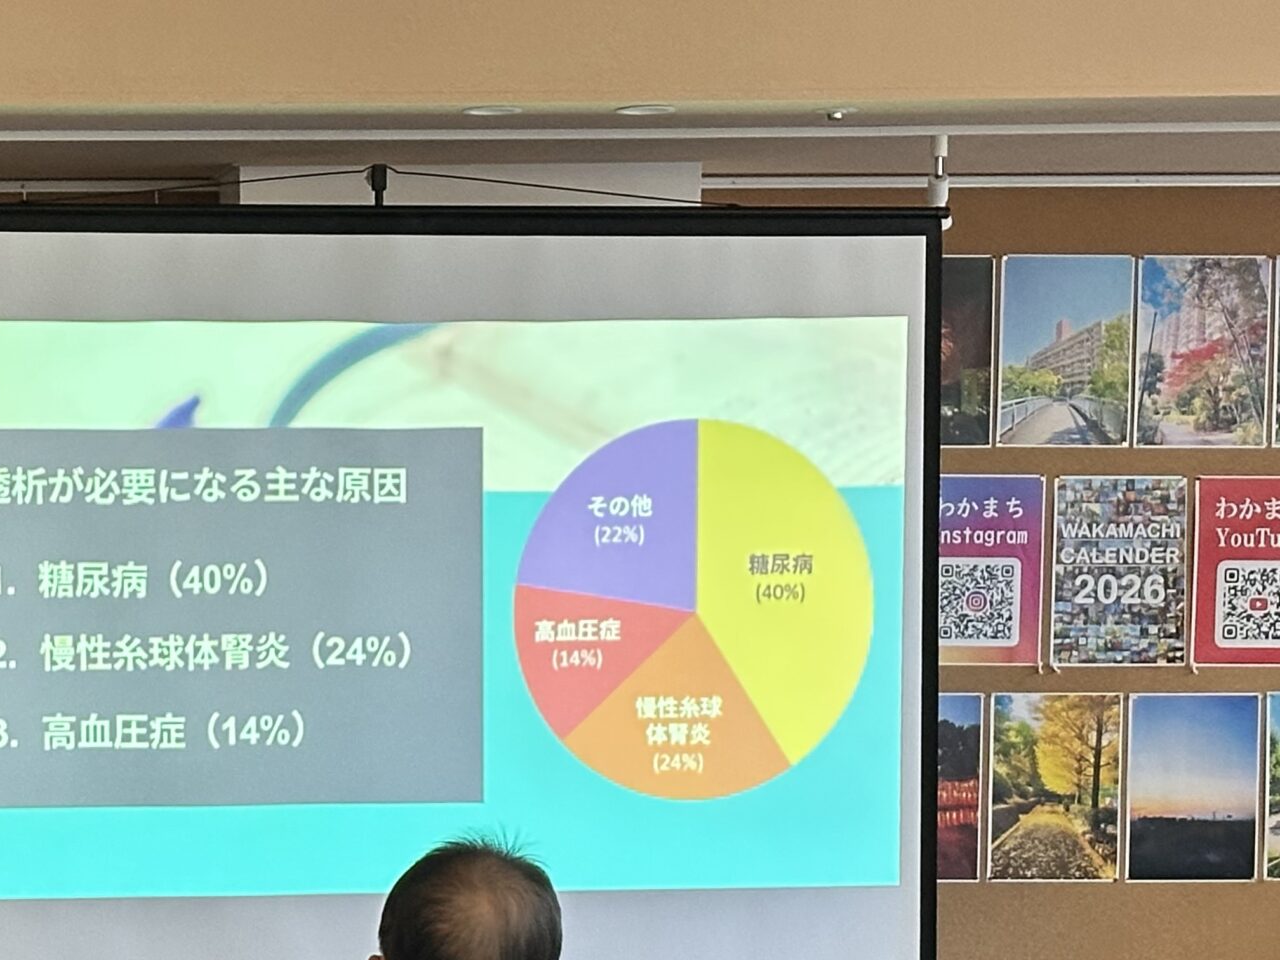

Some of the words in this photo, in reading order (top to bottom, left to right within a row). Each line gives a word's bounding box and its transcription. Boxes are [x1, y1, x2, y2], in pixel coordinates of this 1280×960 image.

[587, 495, 653, 518] その他
[594, 525, 645, 546] (22%)
[1061, 523, 1181, 539] WAKAMACHI
[749, 553, 814, 575] 糖尿病
[1060, 548, 1180, 564] CALENDER
[755, 582, 806, 604] (40%)
[1074, 574, 1166, 604] 2026
[534, 619, 621, 642] 高血圧症
[552, 649, 603, 670] (14%)
[635, 696, 724, 719] 慢性糸球
[646, 723, 711, 745] 体腎炎
[652, 752, 704, 774] (24%)
